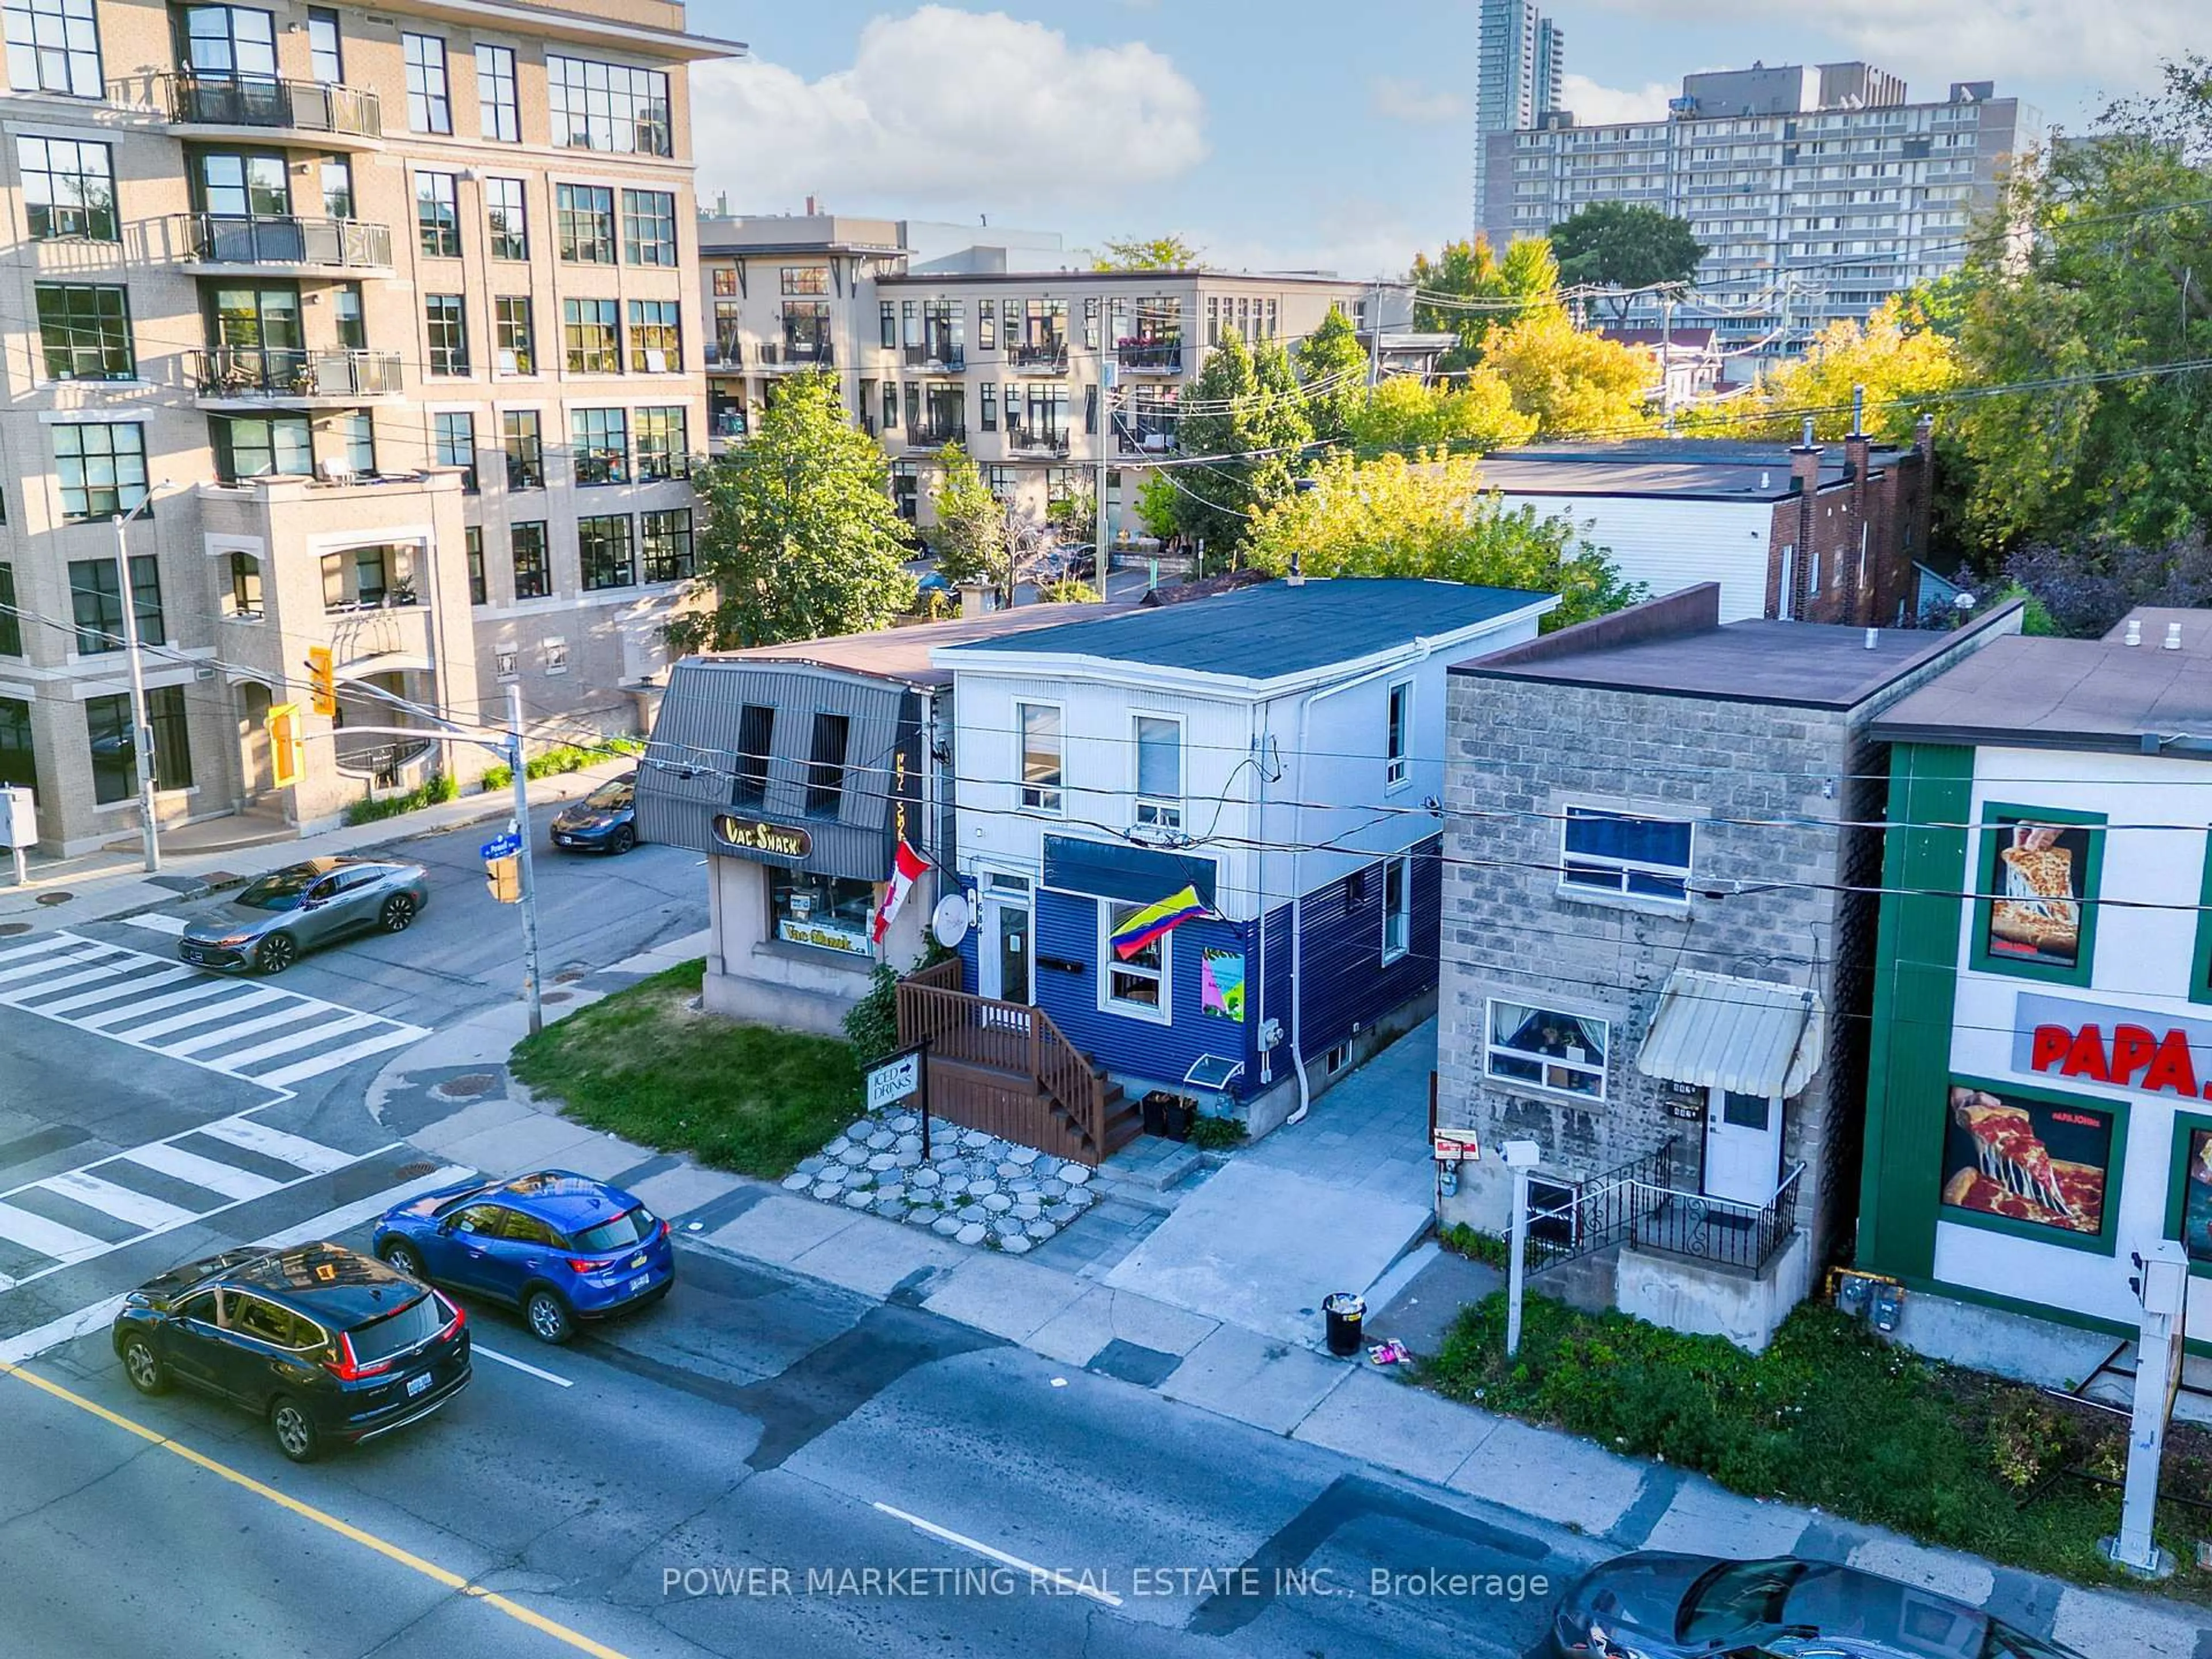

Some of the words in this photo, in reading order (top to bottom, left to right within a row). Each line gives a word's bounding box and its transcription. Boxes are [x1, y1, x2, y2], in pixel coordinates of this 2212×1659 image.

[783, 923, 808, 942] Vac
[2031, 1023, 2198, 1097] PAPA
[874, 1067, 899, 1088] ICED
[874, 1074, 911, 1101] DRINKS
